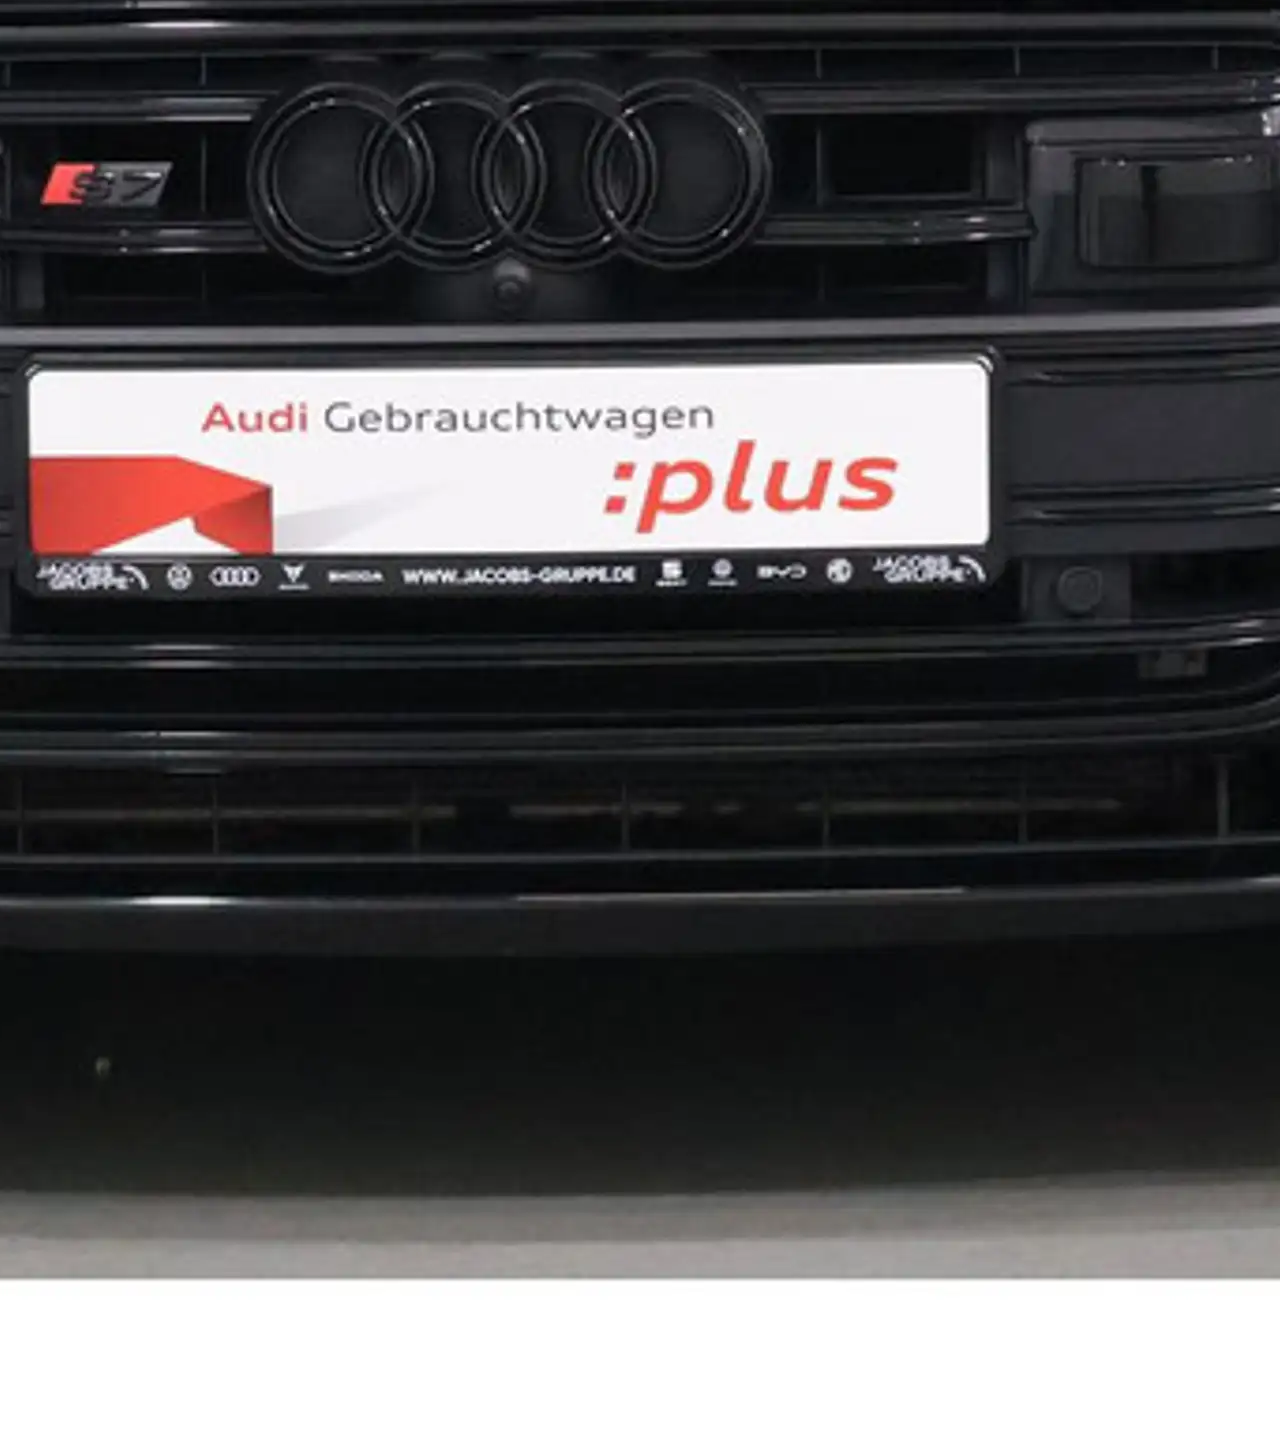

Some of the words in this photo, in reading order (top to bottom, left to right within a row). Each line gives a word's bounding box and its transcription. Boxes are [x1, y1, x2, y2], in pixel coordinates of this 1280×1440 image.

[66, 167, 165, 204] S7
[201, 402, 308, 433] Audi
[324, 401, 715, 439] Gebrauchtwagen
[604, 439, 899, 534] :plus
[872, 554, 950, 571] JACOBS
[49, 574, 128, 590] GRUPPE
[401, 566, 636, 585] WWW.JACOBS-GRUPPE.DE
[884, 566, 965, 583] GRUPPE
